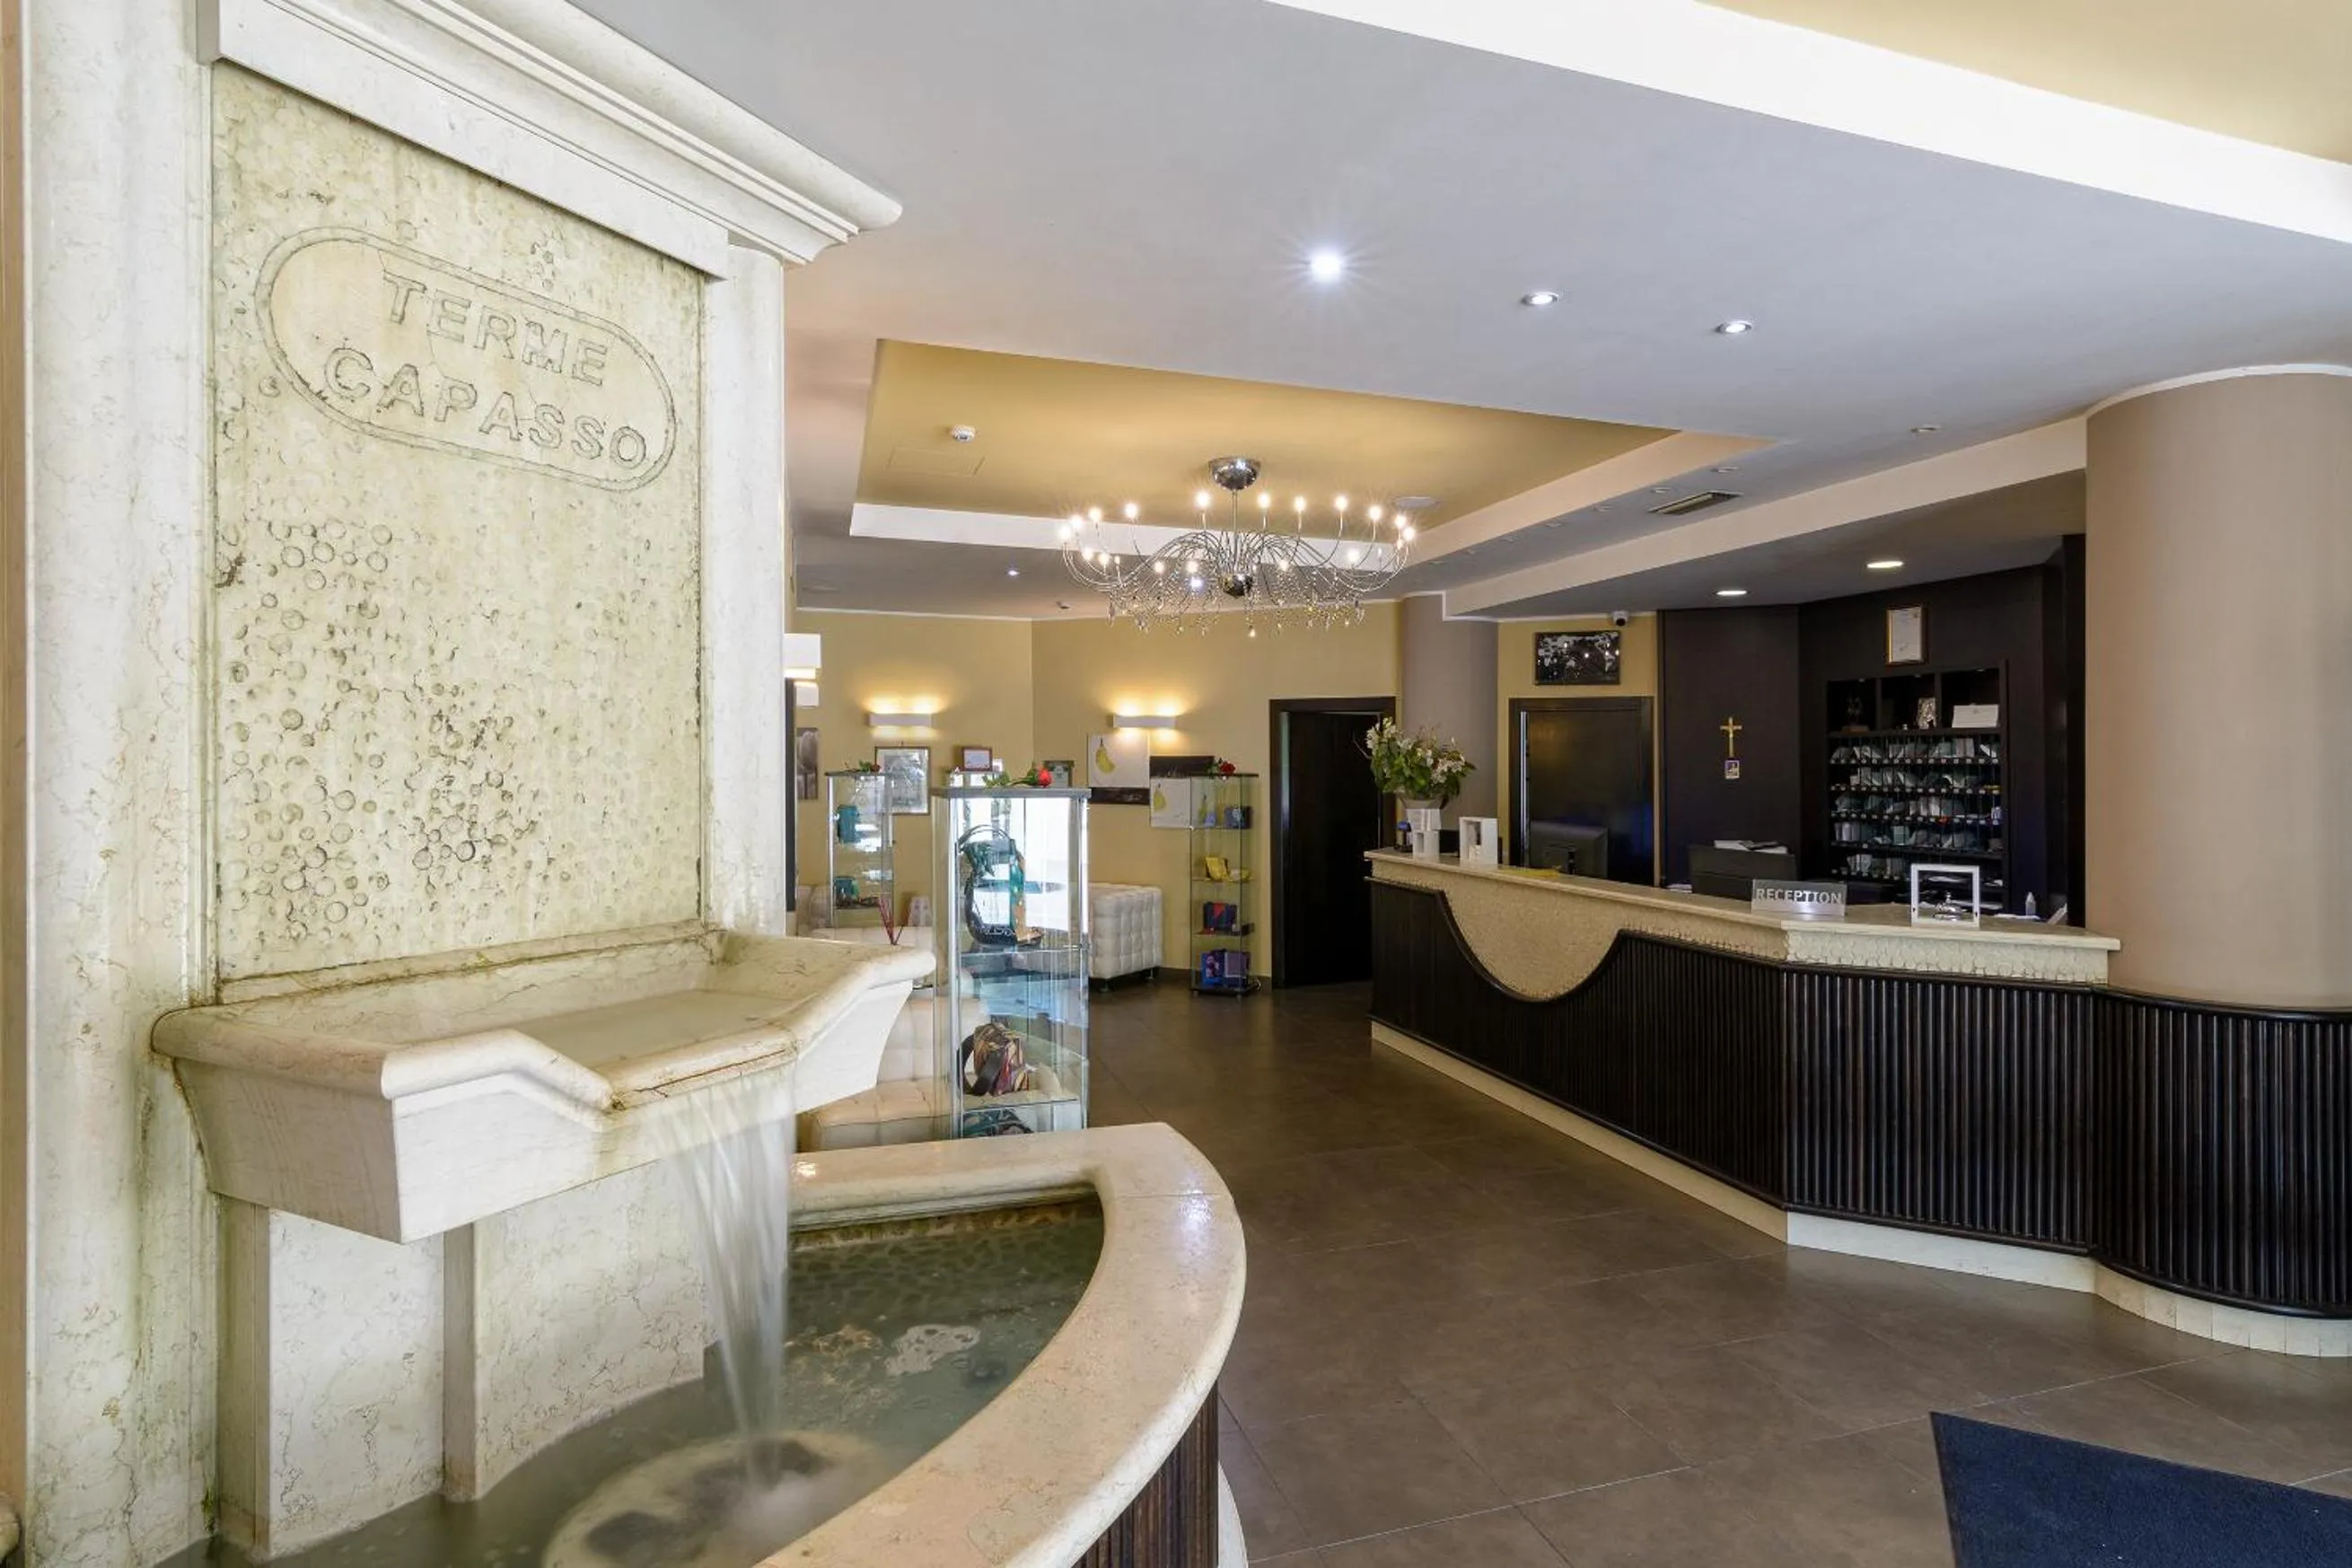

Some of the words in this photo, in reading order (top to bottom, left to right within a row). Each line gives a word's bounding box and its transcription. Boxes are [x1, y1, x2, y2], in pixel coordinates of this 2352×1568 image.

[383, 269, 609, 386] TERME
[324, 347, 647, 469] CAPASSO
[1755, 889, 1842, 905] RECEPTION
